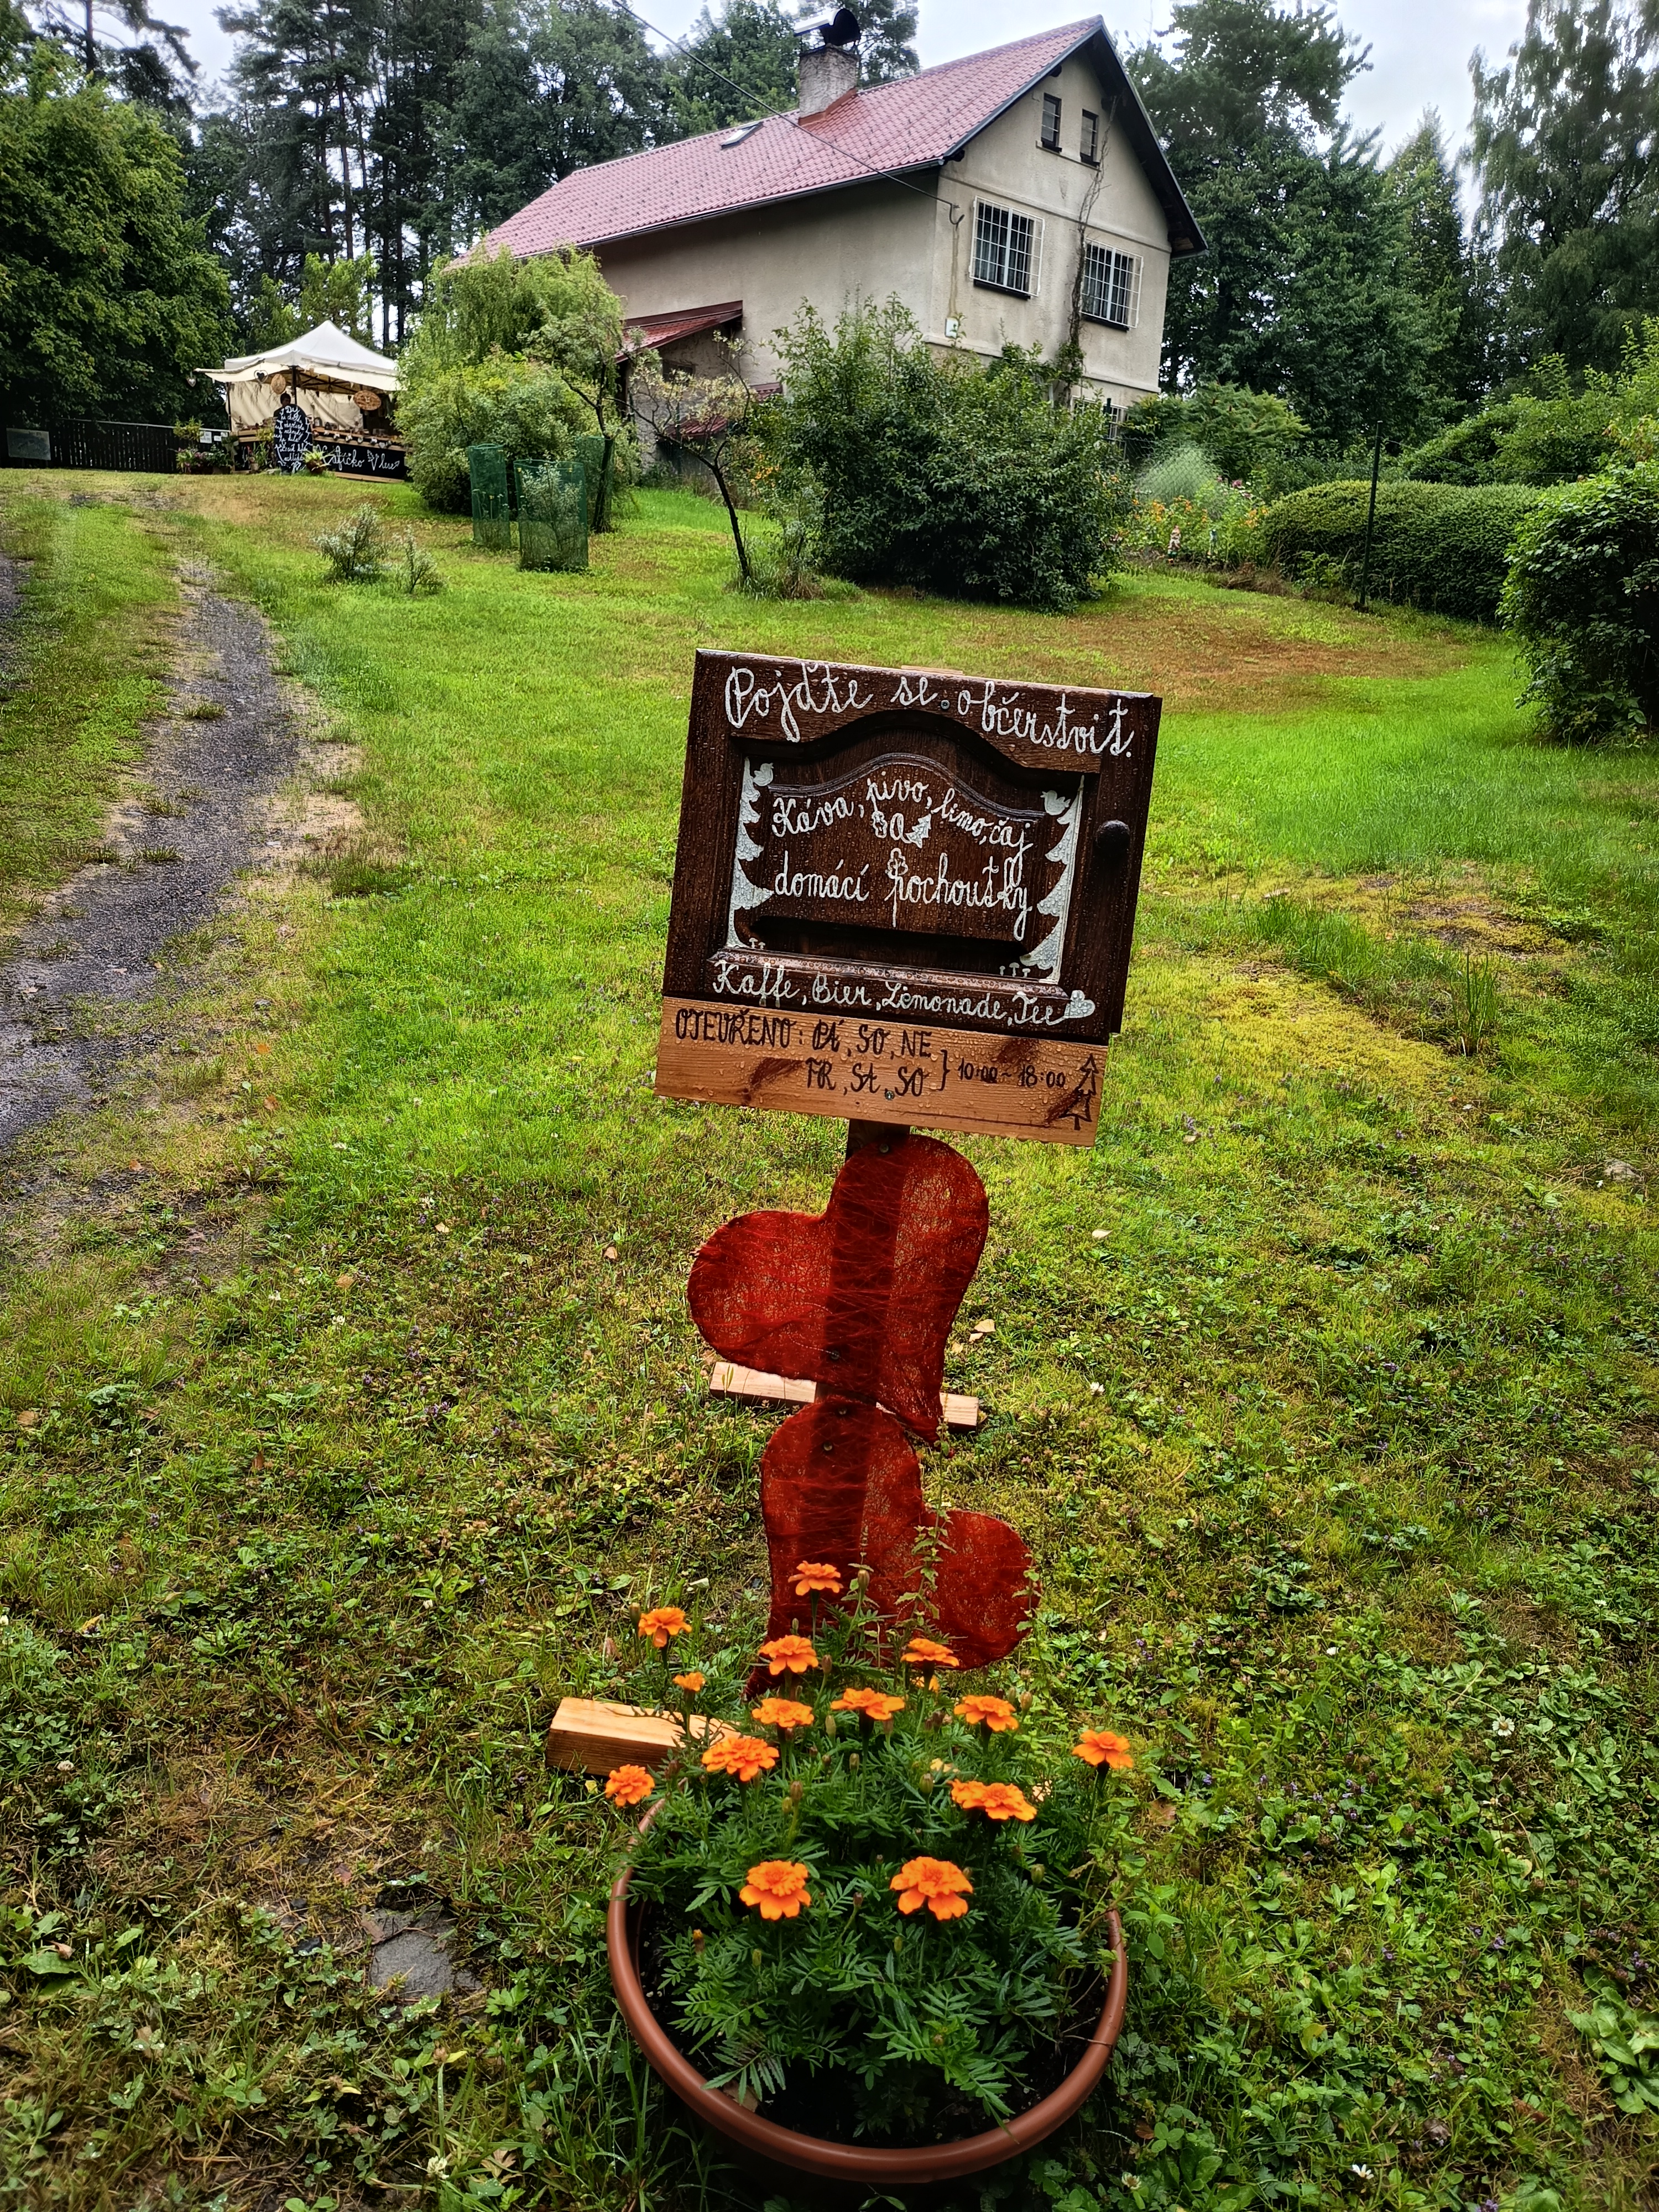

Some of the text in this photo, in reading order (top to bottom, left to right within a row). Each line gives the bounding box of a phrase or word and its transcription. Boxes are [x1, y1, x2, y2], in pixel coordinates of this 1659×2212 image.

[725, 662, 1135, 758] Pojďte se občerstvit.
[771, 771, 1034, 887] Káva, pivo, limo, čaj
[774, 848, 1033, 941] domácí pochoutky
[812, 972, 881, 1011] Bier,
[1012, 990, 1070, 1026] Tee
[901, 1029, 932, 1057] NE
[894, 1066, 933, 1097] SO
